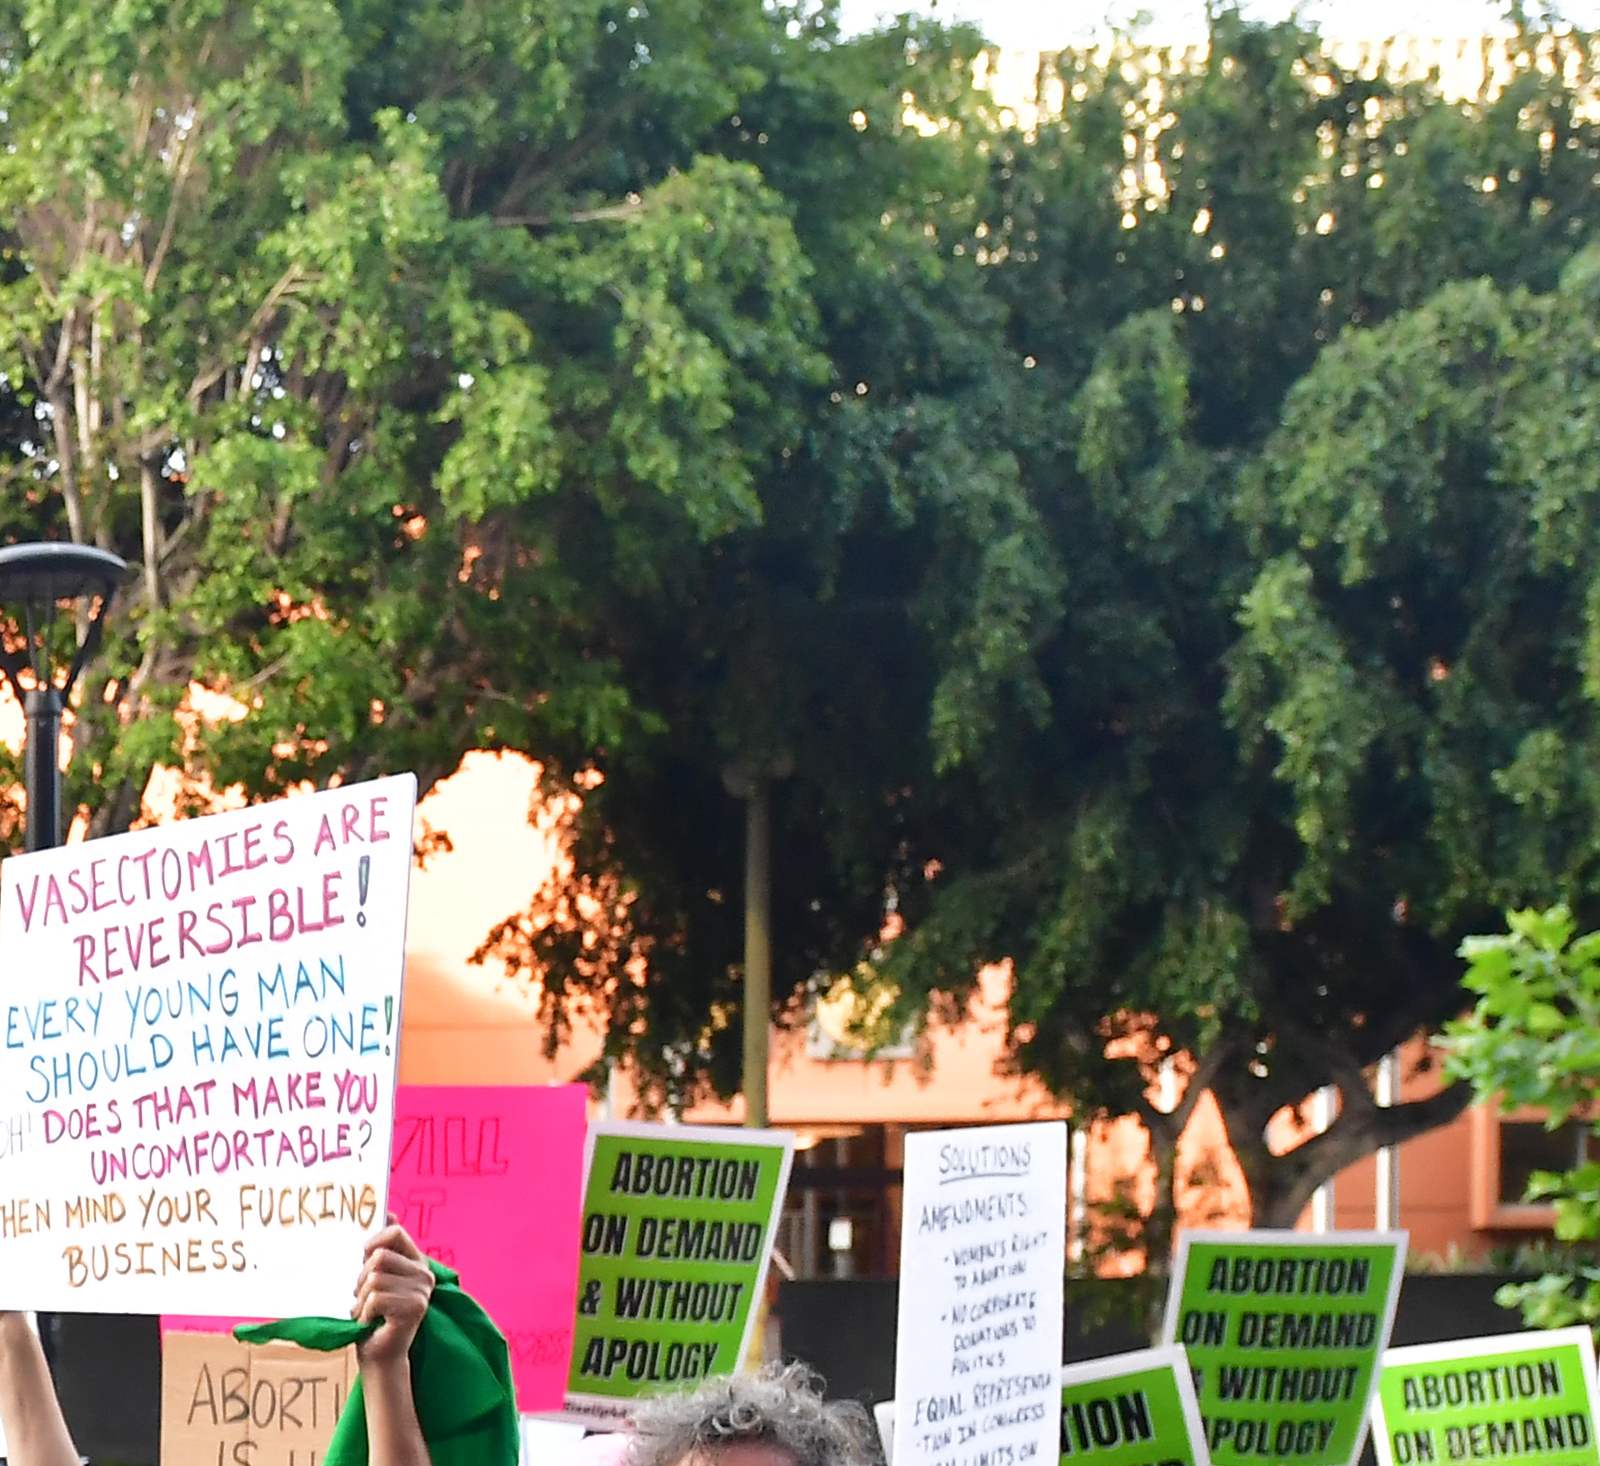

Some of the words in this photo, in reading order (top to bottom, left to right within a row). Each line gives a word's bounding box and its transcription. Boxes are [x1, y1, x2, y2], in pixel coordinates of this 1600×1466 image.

[14, 819, 295, 933] VASECTOMIES
[314, 797, 391, 853] ARE
[74, 855, 371, 986] REVERSIBLE!
[5, 992, 103, 1050] EVERY
[125, 970, 239, 1034] YOUNG
[257, 955, 346, 1010] MAN
[27, 1036, 175, 1103] SHOULD
[192, 1022, 289, 1068] HAVE
[303, 995, 396, 1056] ONE!
[42, 1097, 123, 1145] DOES
[133, 1080, 217, 1139] THAT
[232, 1071, 325, 1121] MAKE
[334, 1069, 378, 1115] YOU
[90, 1121, 372, 1186] UNCOMFORTABLE?
[610, 1152, 760, 1201] ABORTION
[939, 1142, 1031, 1174] SOLUTIONS
[64, 1192, 127, 1230] MIND
[137, 1181, 218, 1232] YOUR
[239, 1183, 377, 1230] FUCKING
[918, 1192, 1028, 1234] AMENDMENTS
[582, 1213, 628, 1255] ON
[636, 1217, 762, 1263] DEMAND
[62, 1240, 258, 1289] BUSINESS.
[1208, 1256, 1370, 1294] ABORTION
[578, 1280, 600, 1316] &
[614, 1278, 743, 1322] WITHOUT
[1183, 1311, 1227, 1346] ON
[1239, 1312, 1377, 1348] DEMAND
[580, 1337, 719, 1381] APOLOGY
[187, 1363, 339, 1431] ABORTI
[1219, 1366, 1358, 1402] WITHOUT
[1404, 1361, 1560, 1410] ABORTION
[913, 1392, 964, 1427] EQUAL
[957, 1419, 977, 1444] IN
[982, 1402, 1046, 1434] CONGRESS
[1019, 1440, 1039, 1462] ON
[1203, 1417, 1336, 1454] POLOGY
[1394, 1430, 1434, 1465] ON
[1446, 1414, 1589, 1460] DEMAND
